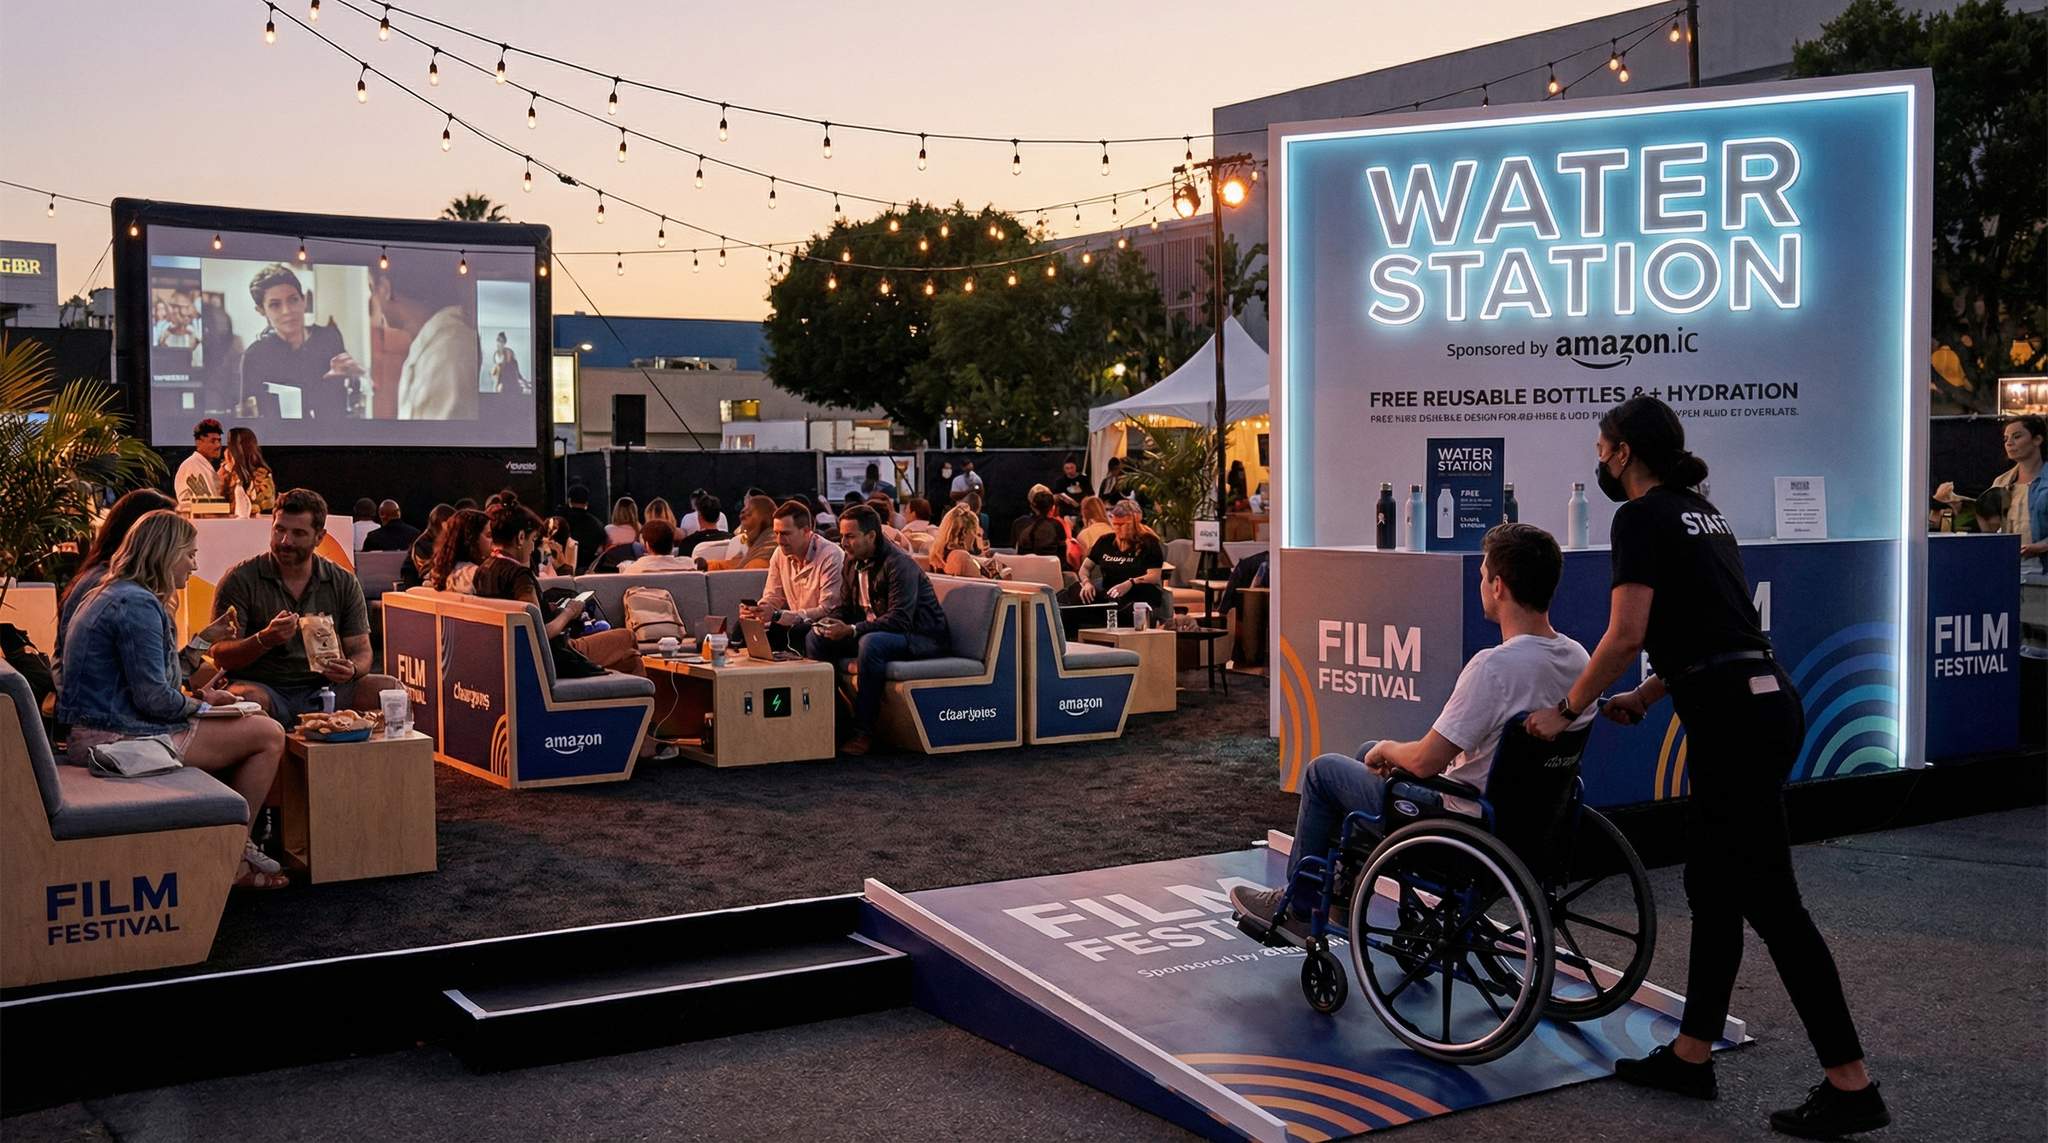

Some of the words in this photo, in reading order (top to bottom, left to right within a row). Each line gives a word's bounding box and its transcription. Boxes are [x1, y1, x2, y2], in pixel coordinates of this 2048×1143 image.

[1366, 137, 1801, 248] WATER
[1368, 234, 1801, 325] STATION
[1447, 341, 1525, 359] Sponsored
[1530, 340, 1548, 357] by
[1370, 391, 1418, 408] FREE
[1423, 388, 1527, 407] REUSABLE
[1532, 386, 1626, 405] BOTTLES
[1667, 382, 1799, 402] HYDRATION
[1438, 447, 1493, 460] WATER
[1438, 460, 1492, 471] STATION
[1318, 619, 1421, 673] FILM
[1935, 612, 2009, 655] FILM
[398, 653, 426, 688] FILM
[1935, 653, 2009, 678] FESTIVAL
[1318, 667, 1421, 702] FESTIVAL
[1059, 697, 1103, 715] amazon
[544, 733, 602, 753] amazon
[46, 872, 178, 921] FILM
[48, 913, 180, 946] FESTIVAL
[1064, 917, 1240, 962] FEST
[1137, 955, 1234, 979] Sponsored
[1234, 951, 1259, 965] by
